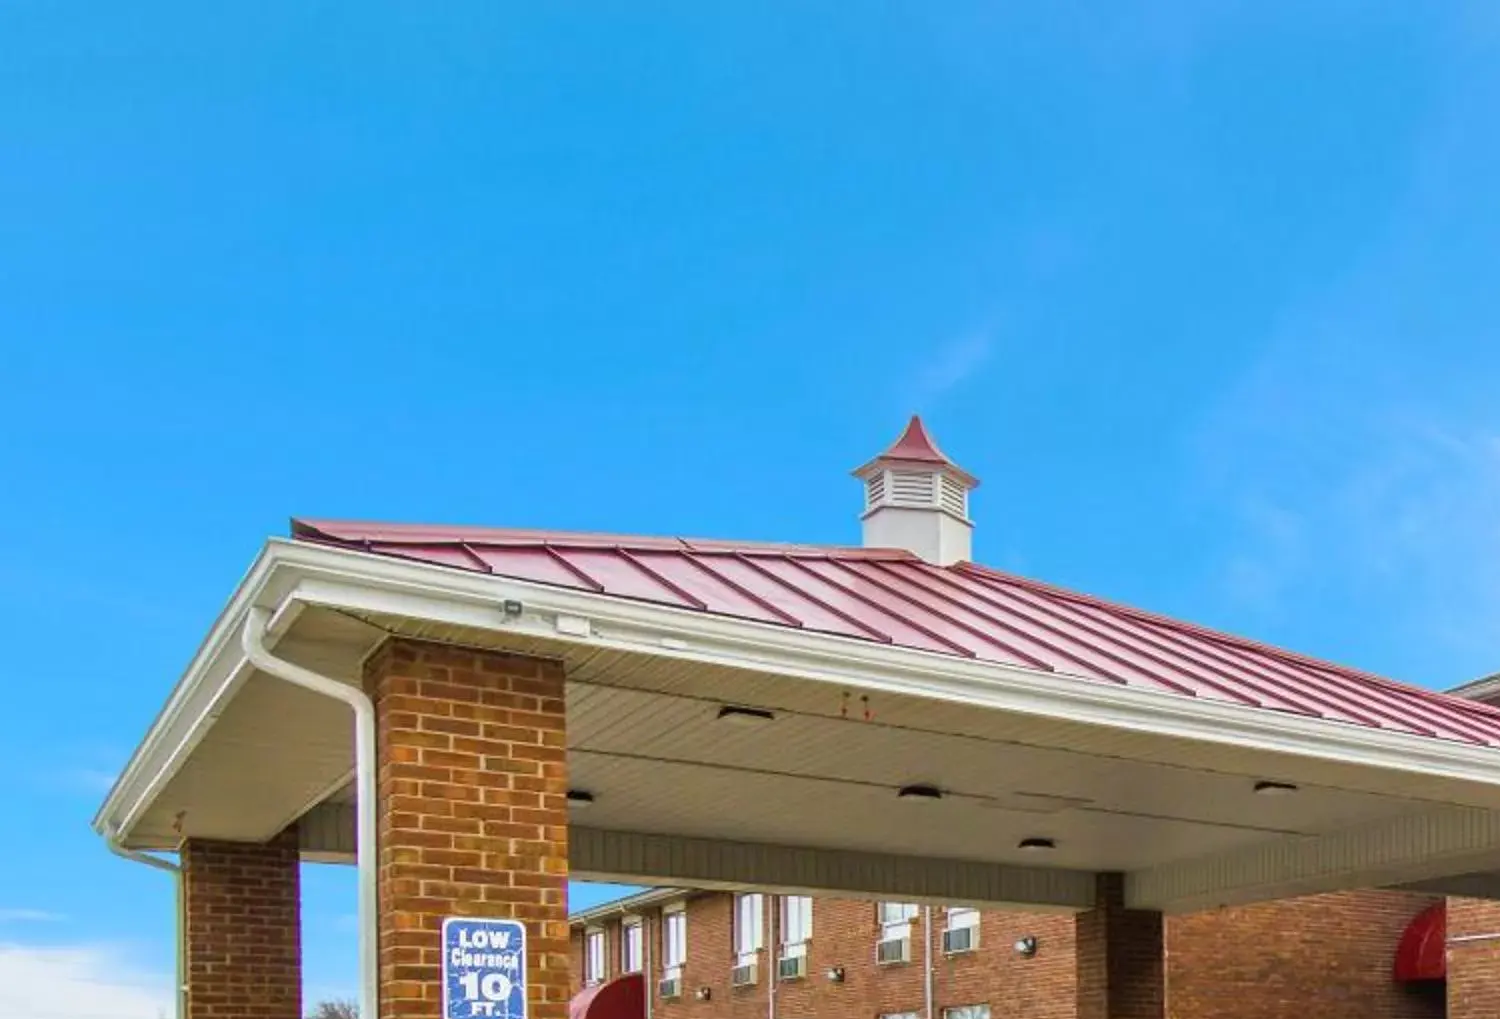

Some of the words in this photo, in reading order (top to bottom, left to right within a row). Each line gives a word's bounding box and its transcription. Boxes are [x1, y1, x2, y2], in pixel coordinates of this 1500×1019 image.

[459, 928, 510, 949] LOW
[459, 971, 512, 1001] 10
[471, 1001, 501, 1017] FT.
